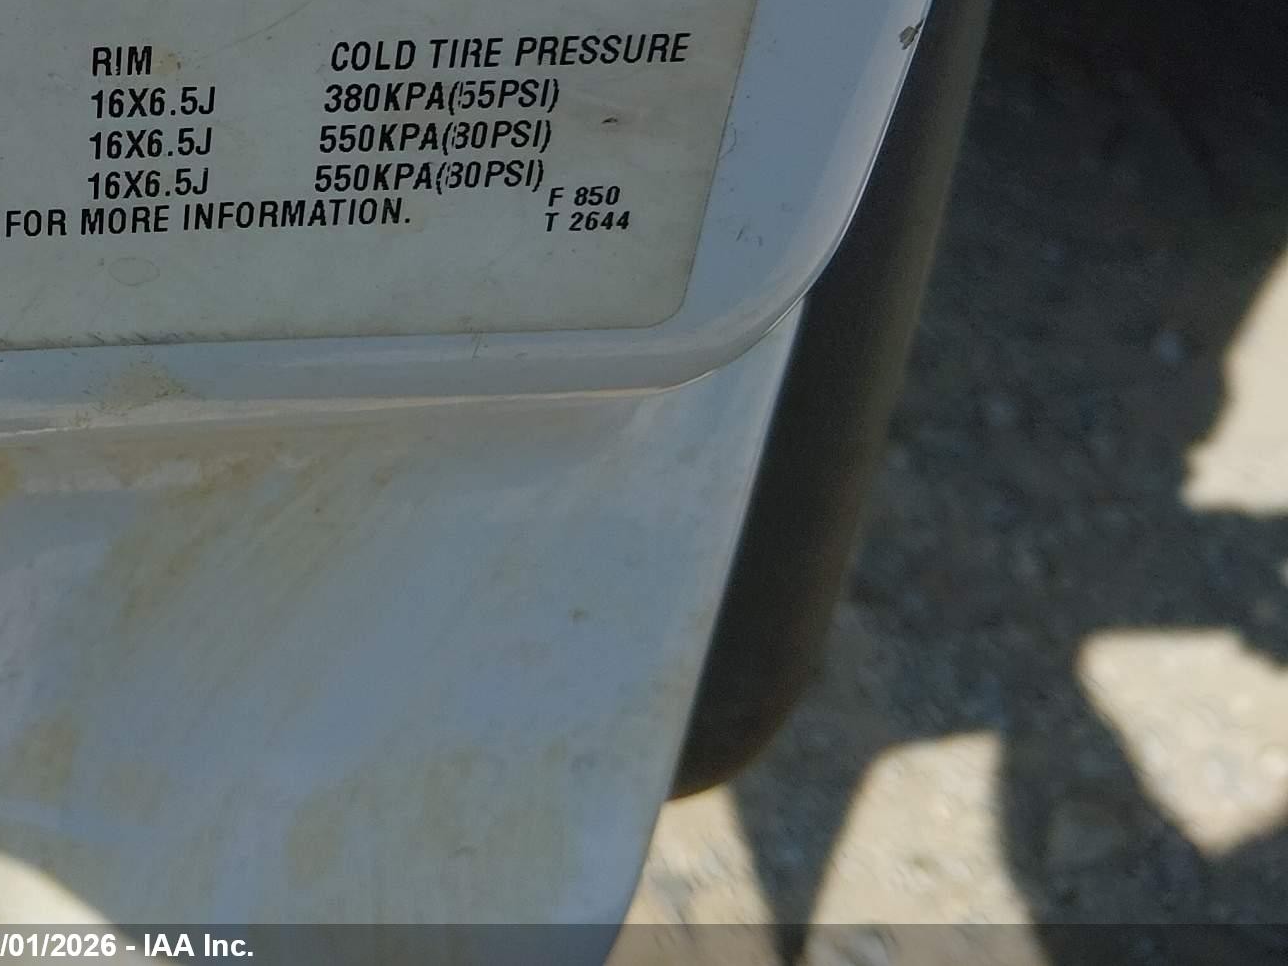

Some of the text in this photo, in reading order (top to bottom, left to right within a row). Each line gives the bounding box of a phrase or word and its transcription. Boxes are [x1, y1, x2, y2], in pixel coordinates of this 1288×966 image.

[92, 46, 152, 76] RIM
[331, 33, 691, 71] COLD TIRE PRESSURE
[91, 86, 215, 118] 16X6.5J
[324, 79, 560, 115] 380KPA(55PSI)
[89, 128, 212, 160] 16X6.5J
[88, 168, 209, 200] 16X6.5J
[548, 186, 620, 207] F 850
[5, 210, 66, 237] FOR
[81, 207, 170, 235] MORE
[183, 197, 410, 231] INFORMATION.
[545, 211, 630, 232] T 2644
